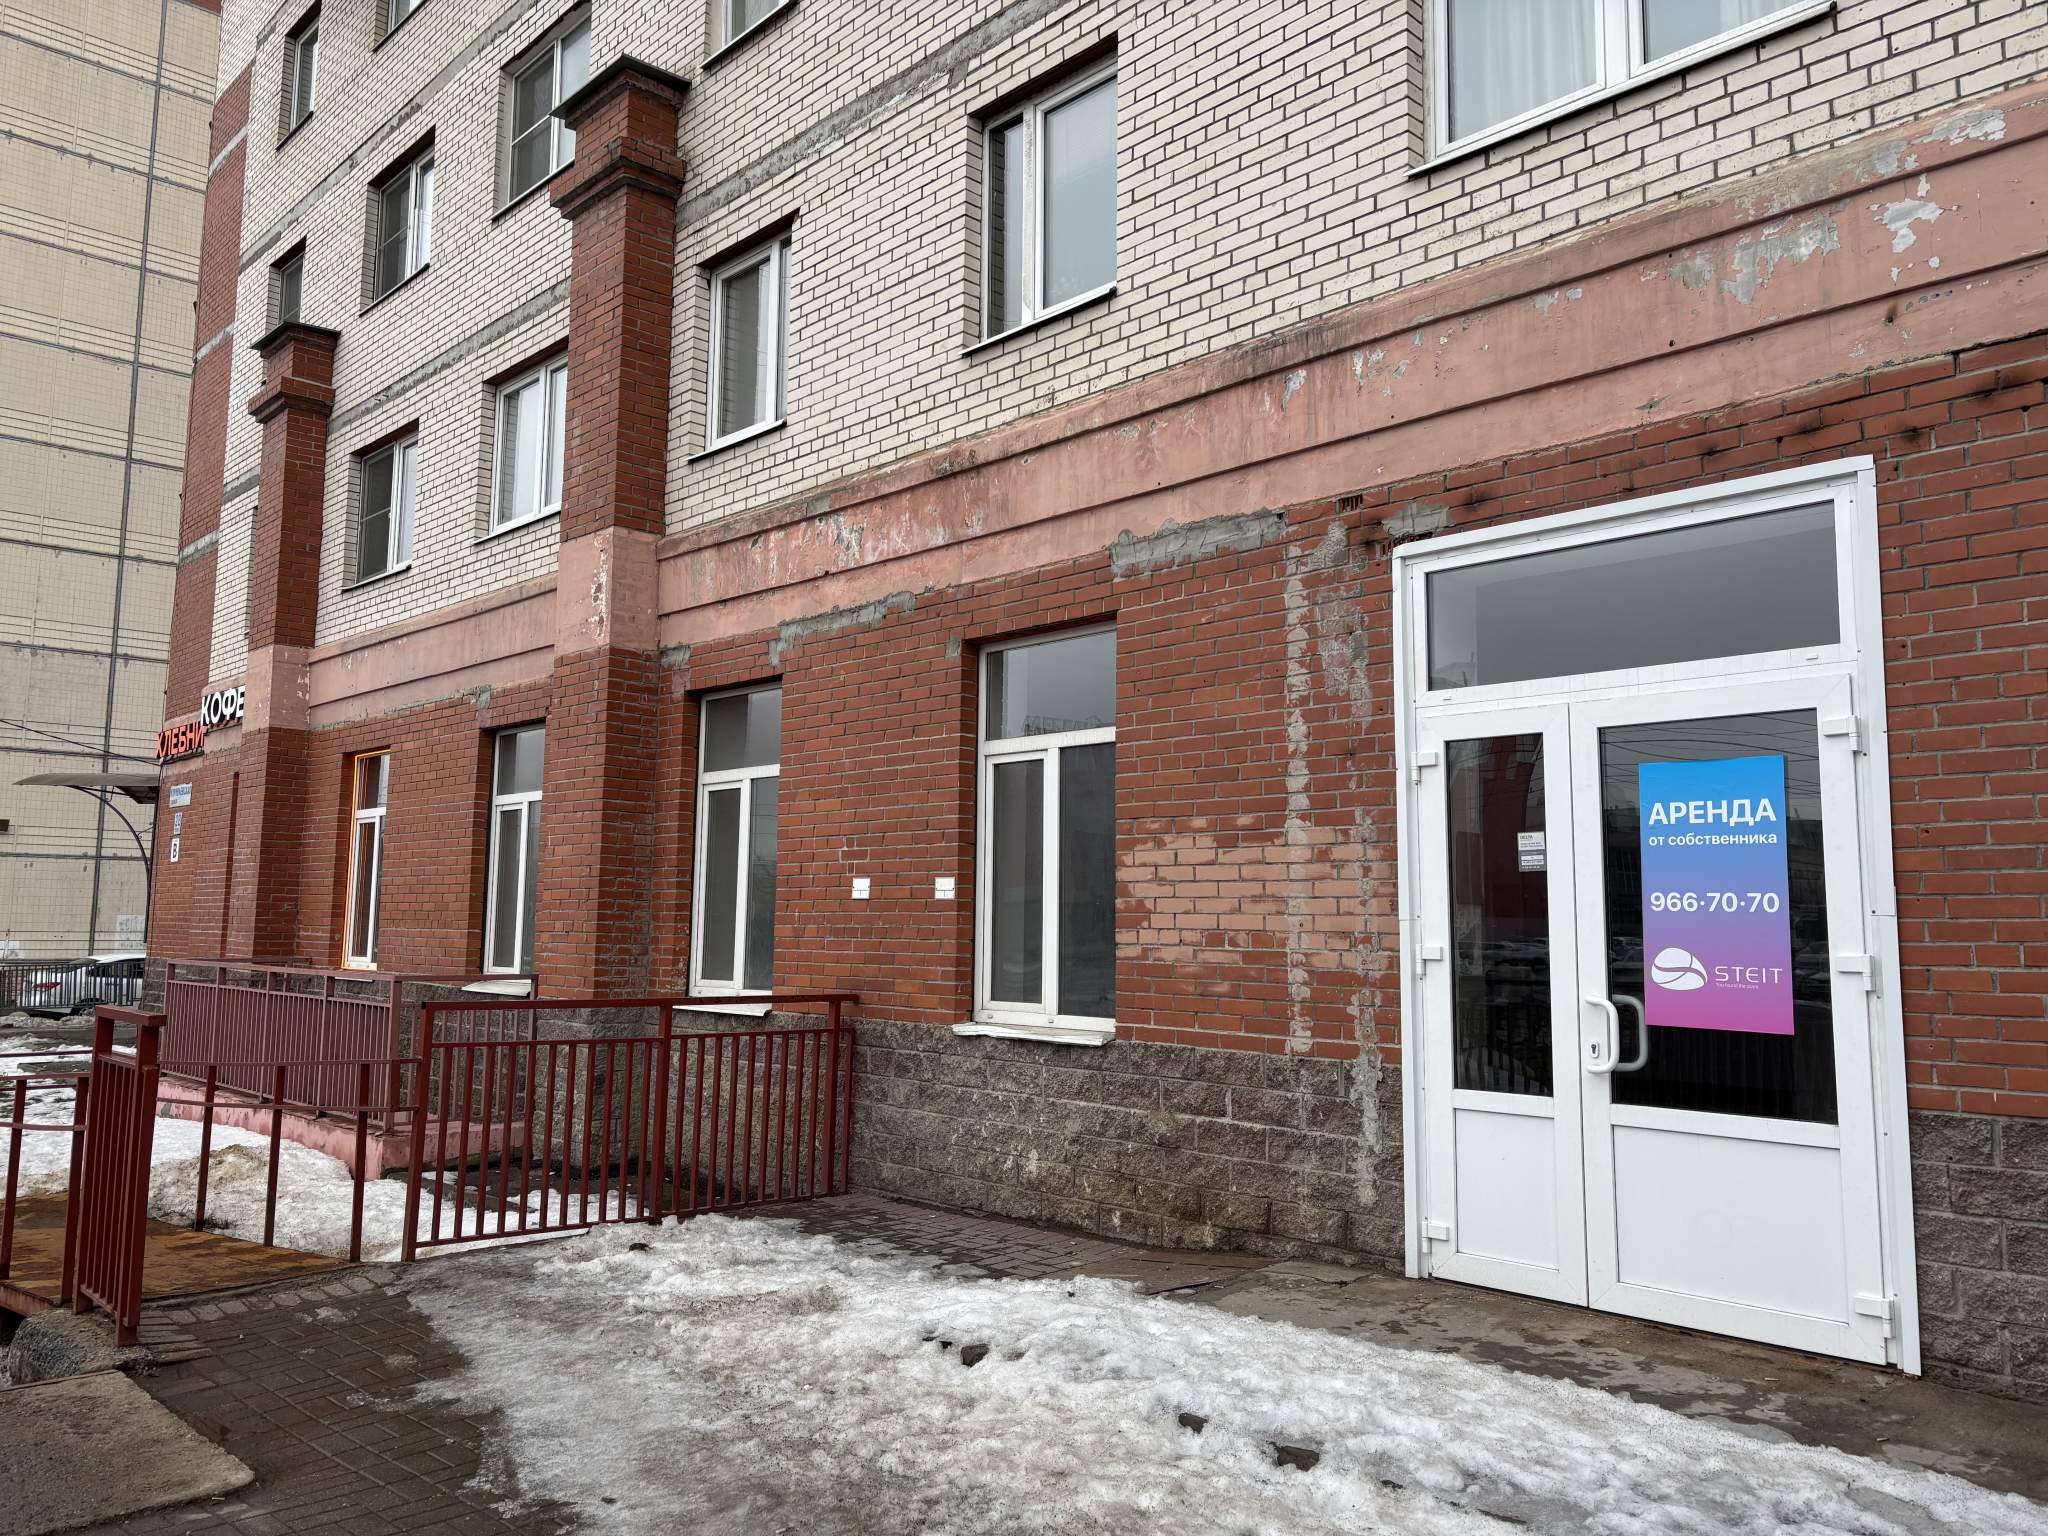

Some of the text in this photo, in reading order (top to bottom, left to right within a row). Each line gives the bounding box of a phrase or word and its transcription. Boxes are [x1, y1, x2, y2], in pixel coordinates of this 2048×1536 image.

[201, 686, 245, 726] КОФЕ
[1648, 798, 1777, 827] АРЕНДА
[1648, 832, 1777, 846] от собственника
[1715, 966, 1783, 983] STEIT
